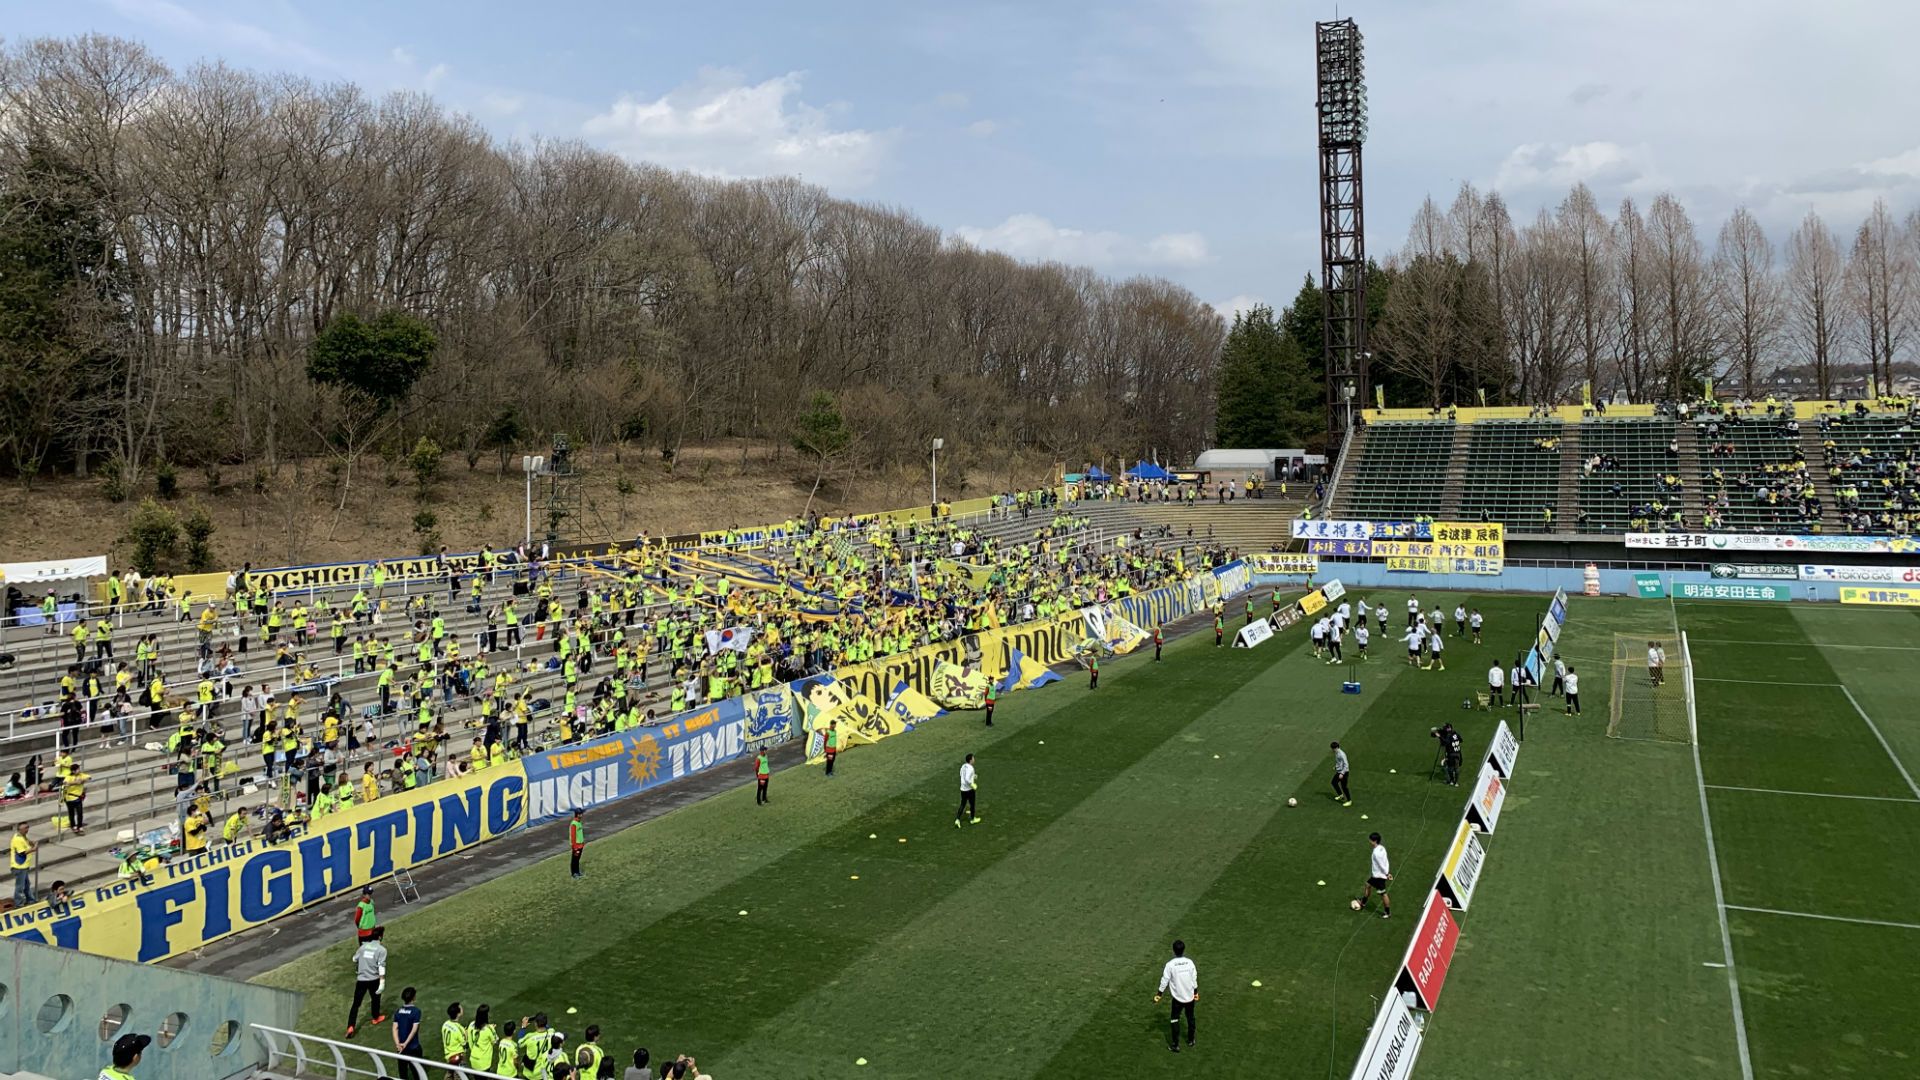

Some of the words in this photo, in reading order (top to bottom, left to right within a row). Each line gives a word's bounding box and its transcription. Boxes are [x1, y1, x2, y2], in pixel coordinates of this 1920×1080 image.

[1297, 521, 1366, 538] 大黒将志
[1438, 528, 1472, 541] 古波津
[1312, 541, 1337, 554] 本庄
[1665, 535, 1708, 547] 益子町
[1734, 536, 1770, 544] 大田原市
[1838, 571, 1870, 580] TOKYO
[1872, 572, 1892, 581] GAS
[1683, 584, 1776, 599] 明治安田生命
[529, 762, 619, 820] HIGH
[668, 719, 745, 779] TIME
[136, 776, 524, 963] FIGHTING
[0, 897, 86, 931] lways
[96, 874, 155, 902] here
[166, 840, 253, 879] TOCHIGI
[1432, 911, 1450, 951] BERRY
[1377, 1012, 1413, 1080] AYABUSA.COM
